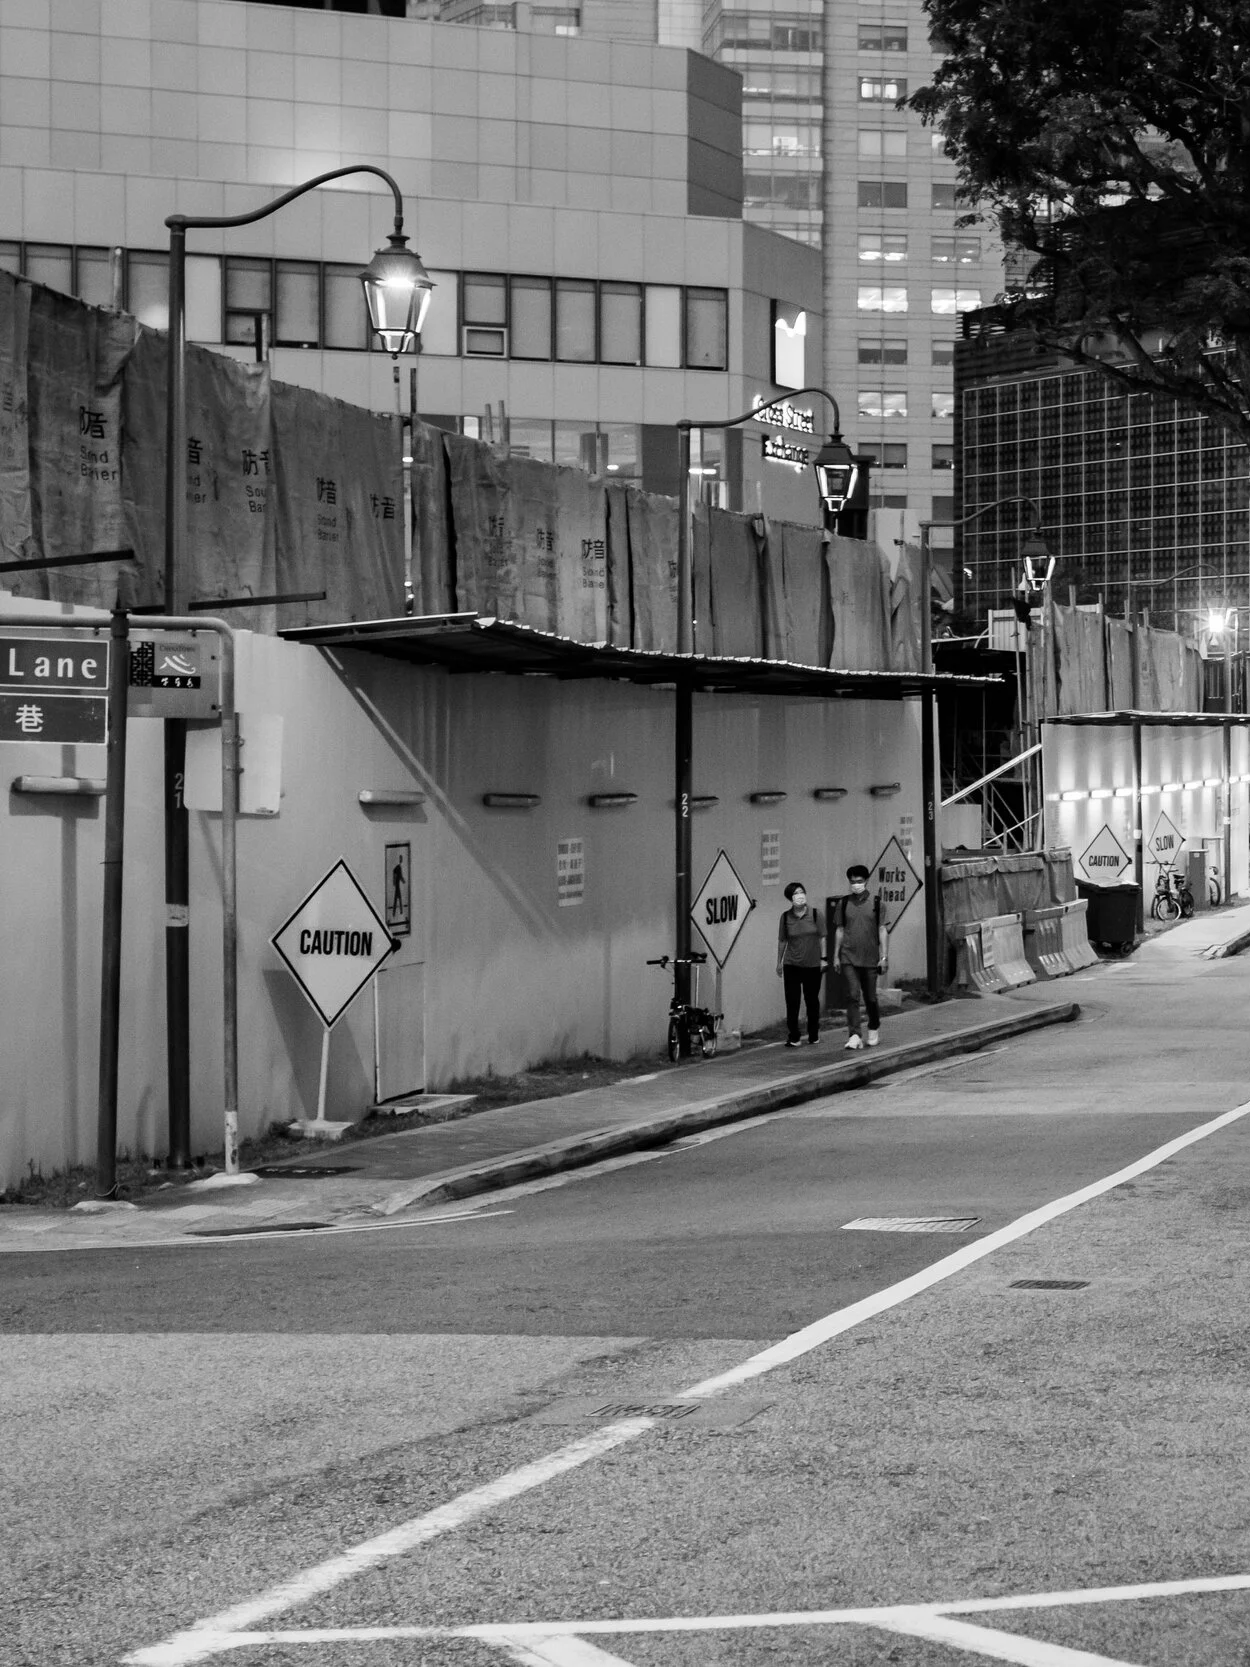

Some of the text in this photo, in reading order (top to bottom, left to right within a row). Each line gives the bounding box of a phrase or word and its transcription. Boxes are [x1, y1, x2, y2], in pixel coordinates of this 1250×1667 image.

[8, 647, 98, 679] Lane
[15, 704, 44, 733] 巷
[1155, 834, 1175, 852] SLOW
[878, 866, 906, 883] Works
[1088, 855, 1120, 867] CAUTION
[705, 894, 739, 925] SLOW
[299, 929, 373, 957] CAUTION
